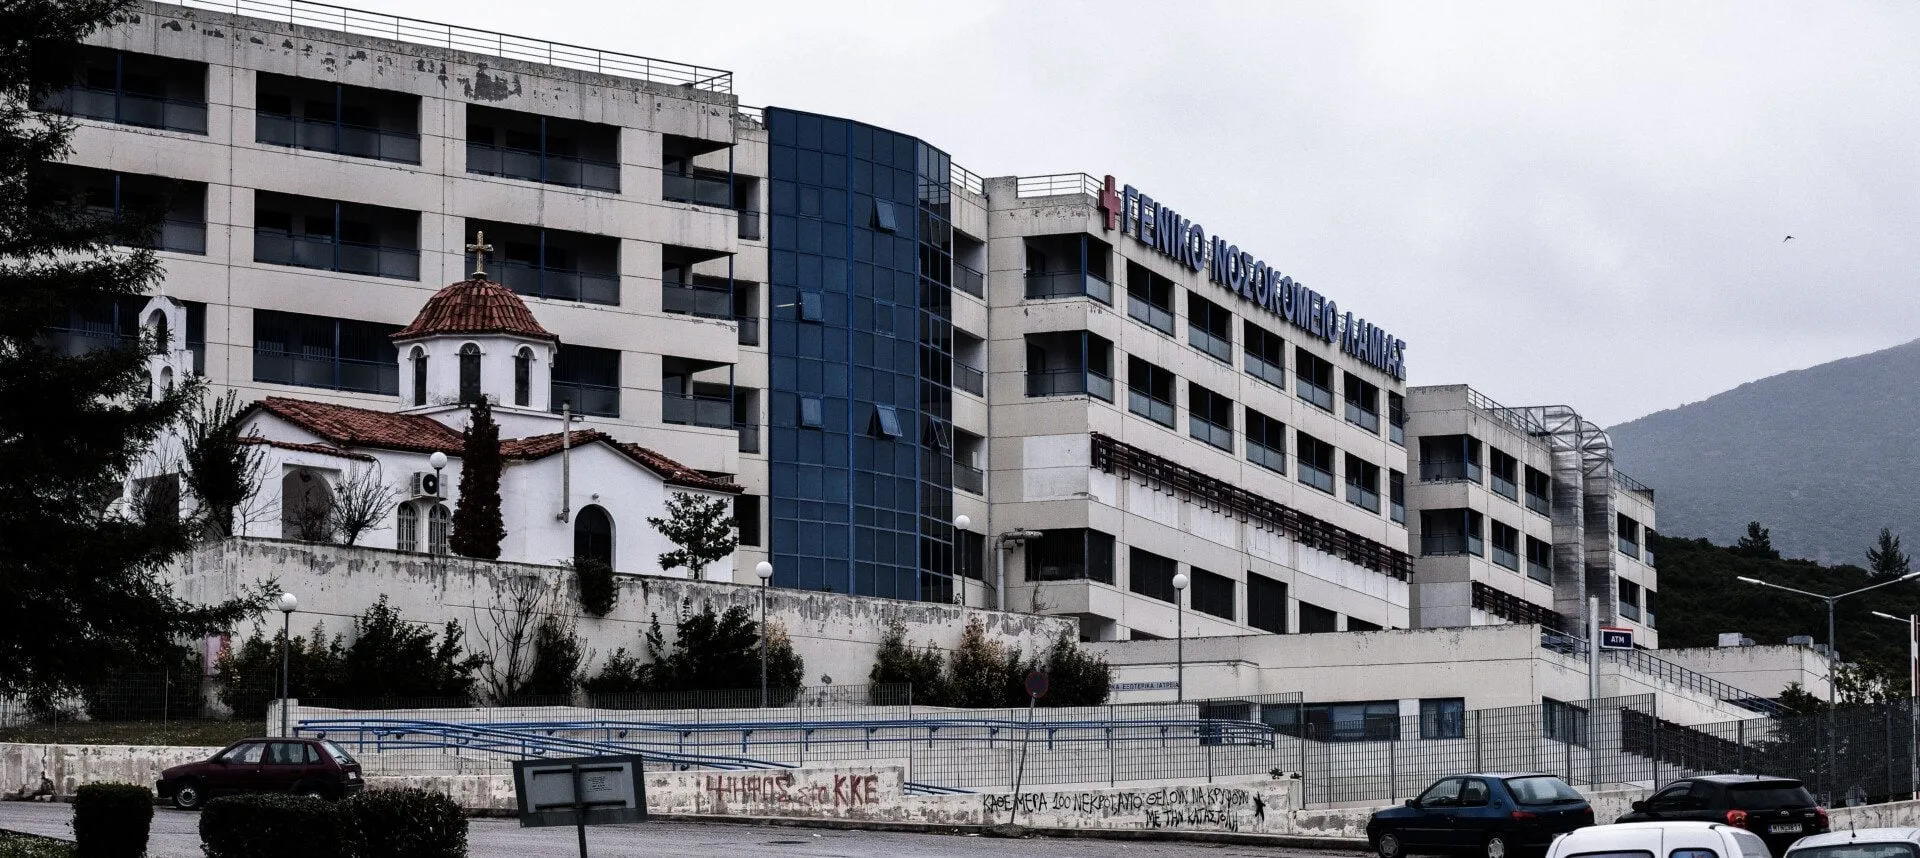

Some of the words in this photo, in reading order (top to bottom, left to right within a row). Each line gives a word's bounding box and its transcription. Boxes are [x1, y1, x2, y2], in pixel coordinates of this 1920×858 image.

[1123, 184, 1205, 272] ΓΕΝΙΚΟ
[1211, 235, 1338, 343] ΝΟΣΟΚΟΜΕΙΟ
[1342, 311, 1407, 381] ΛΑΜΙΑΣ
[1610, 635, 1625, 644] ATM
[834, 774, 879, 808] ΚΚΕ
[983, 793, 1012, 814] ΚΑΘΕ
[1014, 792, 1047, 813] ΜΕΡΑ
[1053, 792, 1071, 810] 100
[1146, 788, 1188, 806] ΘΕΛΟΥΝ
[1192, 786, 1206, 806] ΝΑ
[1146, 810, 1161, 828] ΜΕ
[1163, 810, 1184, 828] ΤΗΝ
